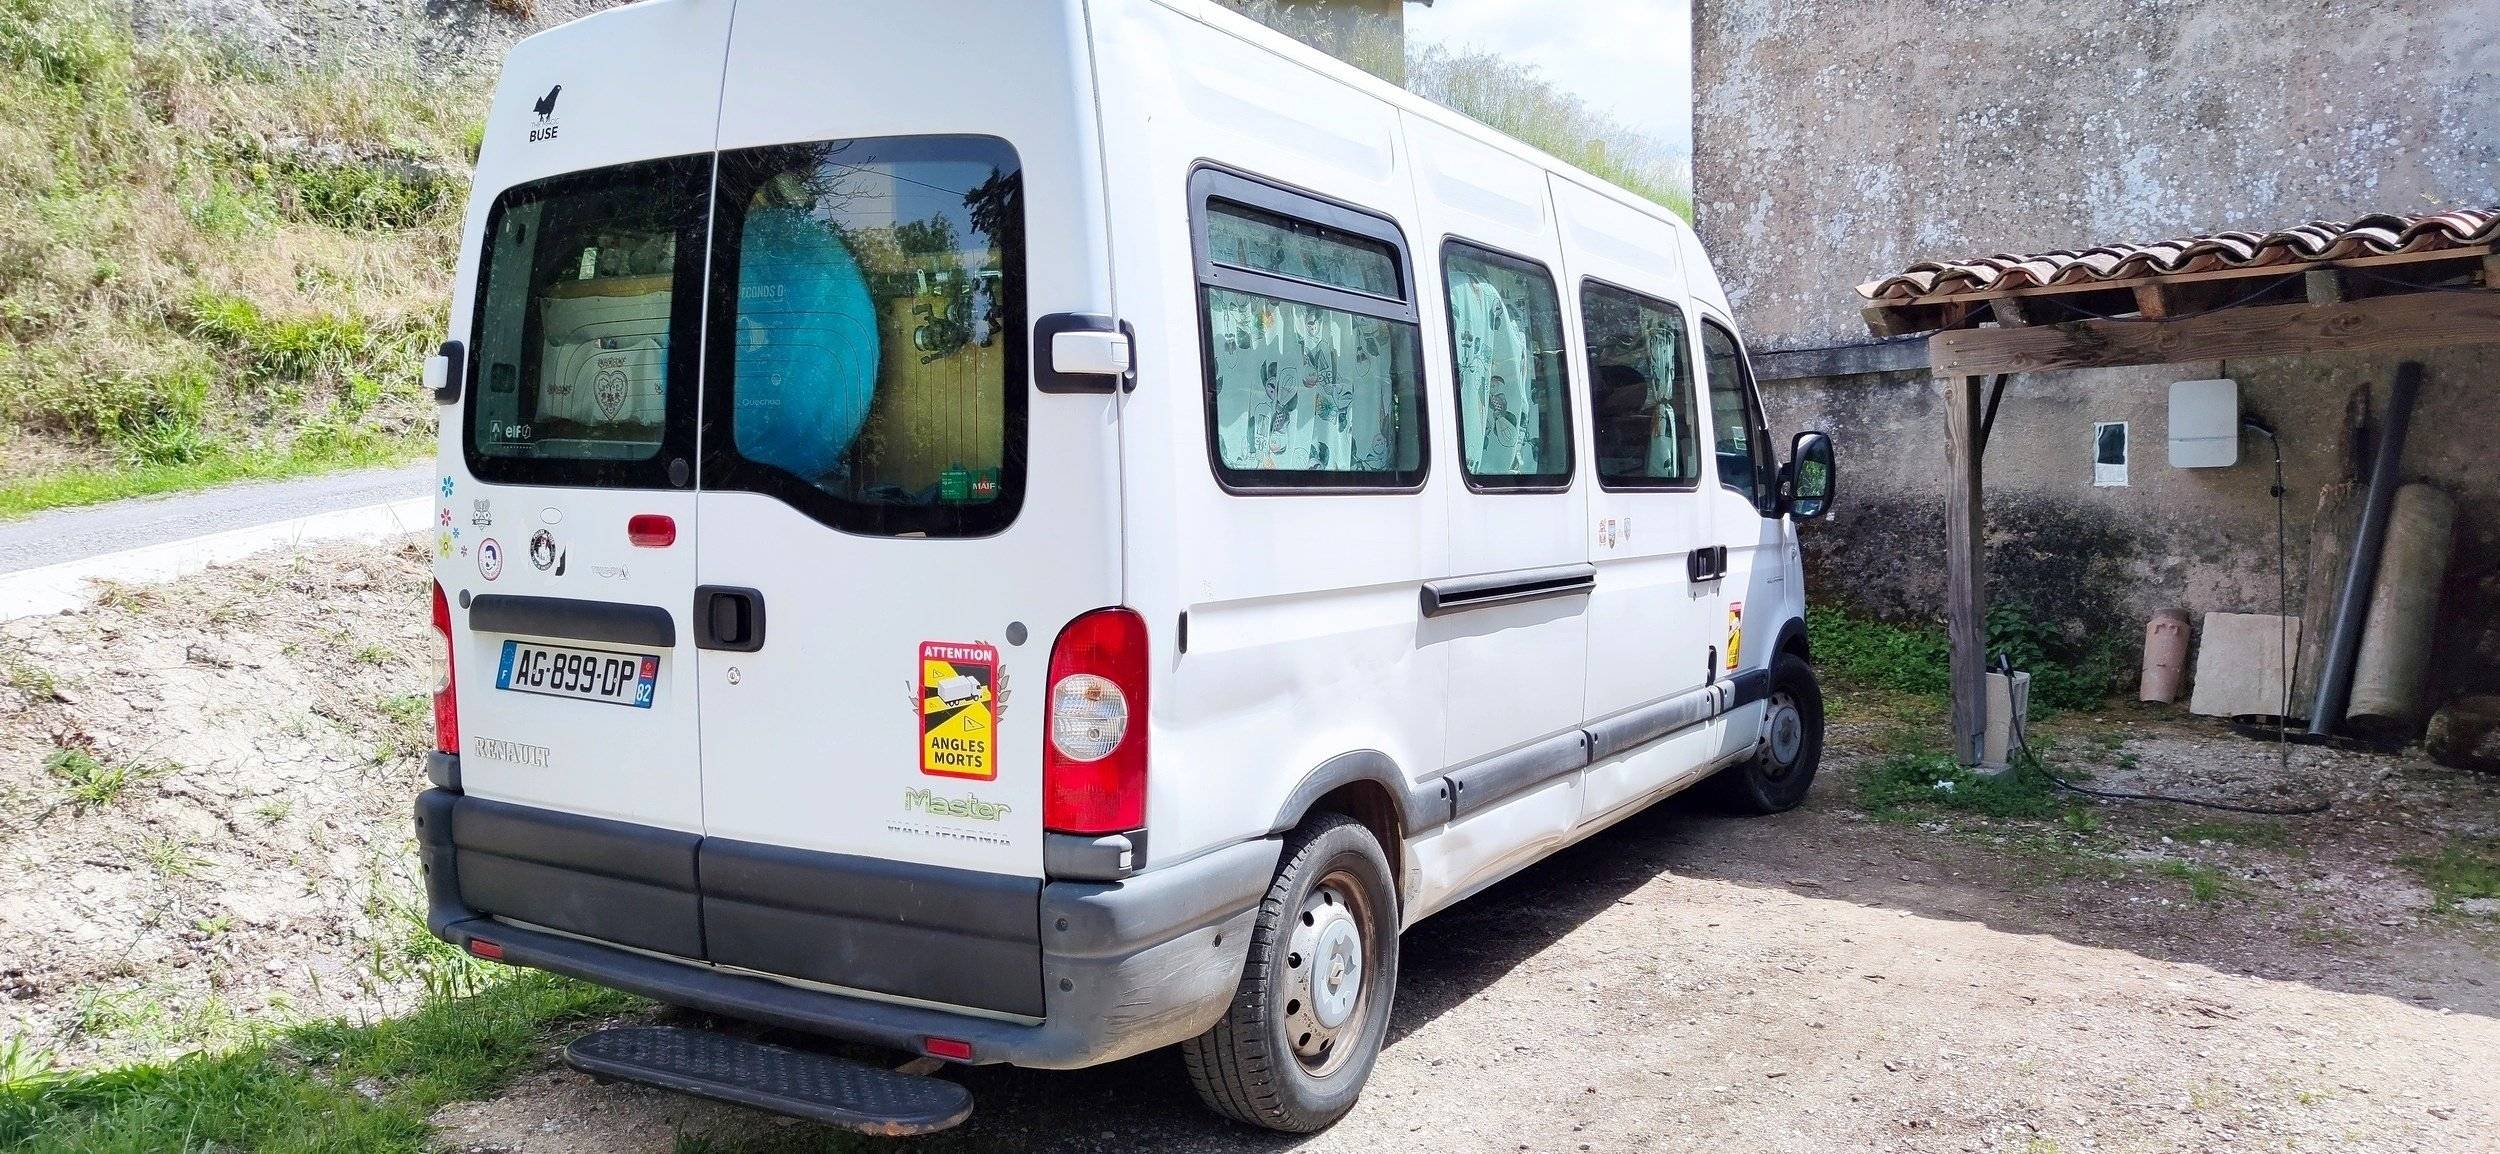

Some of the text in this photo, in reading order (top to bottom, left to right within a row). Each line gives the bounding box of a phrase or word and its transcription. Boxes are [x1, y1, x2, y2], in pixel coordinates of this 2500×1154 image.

[529, 126, 559, 142] BUSE
[972, 482, 996, 490] MAIF
[924, 646, 992, 660] ATTENTION
[501, 649, 652, 702] F AG-899-DP 82
[474, 736, 550, 768] RENAULT
[931, 736, 985, 754] ANGLES
[934, 752, 983, 768] MORTS
[904, 786, 1012, 821] Master
